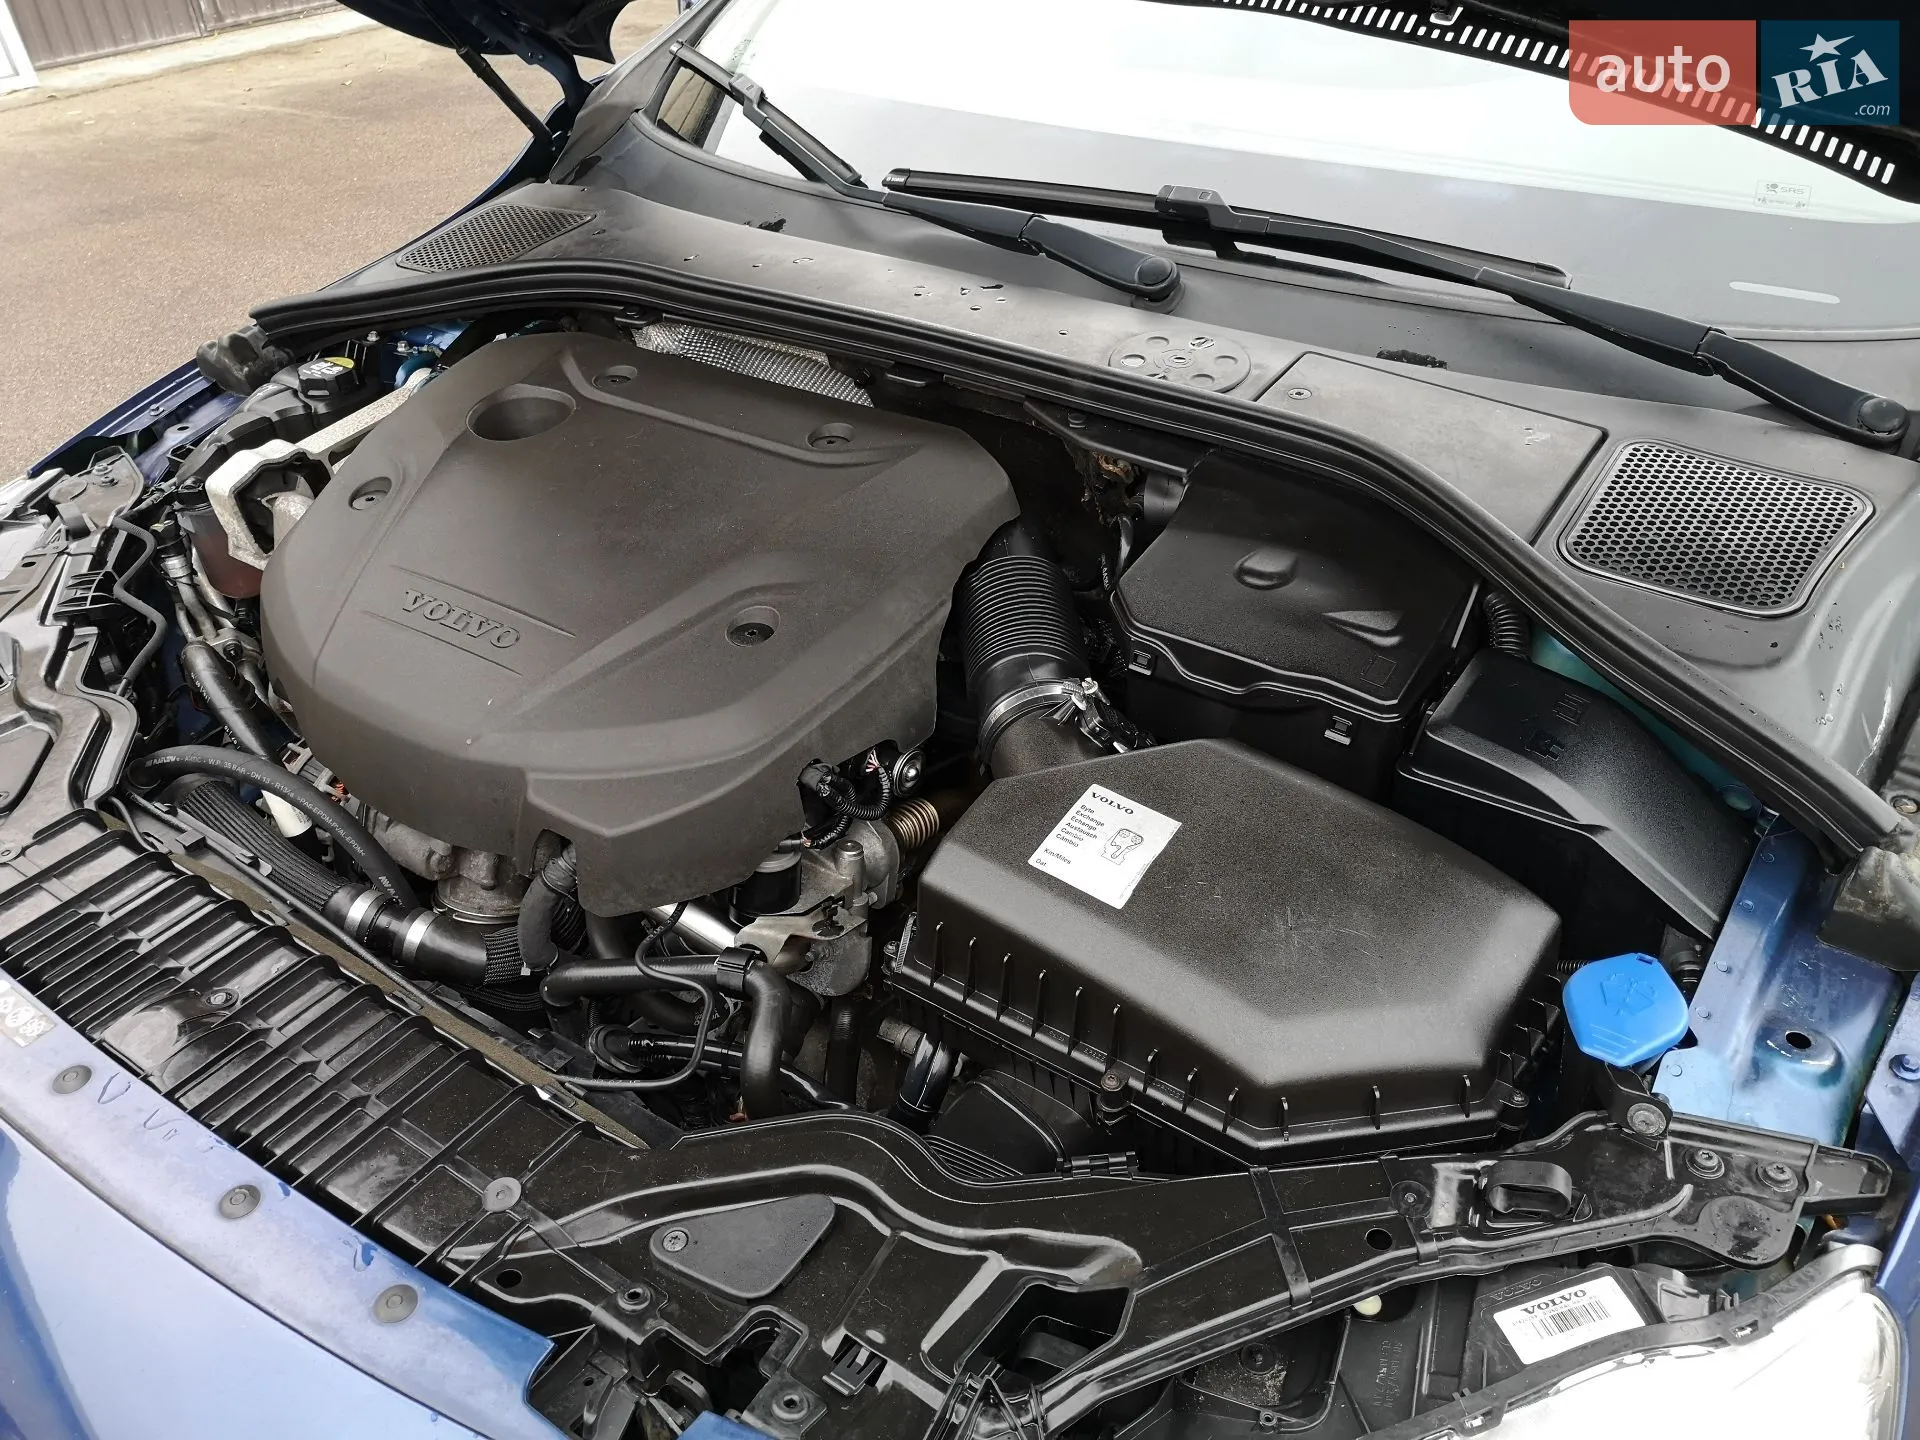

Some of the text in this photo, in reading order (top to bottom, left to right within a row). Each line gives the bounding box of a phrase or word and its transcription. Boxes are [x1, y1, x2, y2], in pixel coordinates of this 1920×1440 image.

[402, 588, 520, 649] VOLVO
[1091, 791, 1134, 815] VOLVO
[1075, 810, 1105, 827] Exchange
[1061, 827, 1084, 841] Cambio
[1065, 822, 1098, 839] Austausch
[1520, 1289, 1587, 1315] VOLVO
